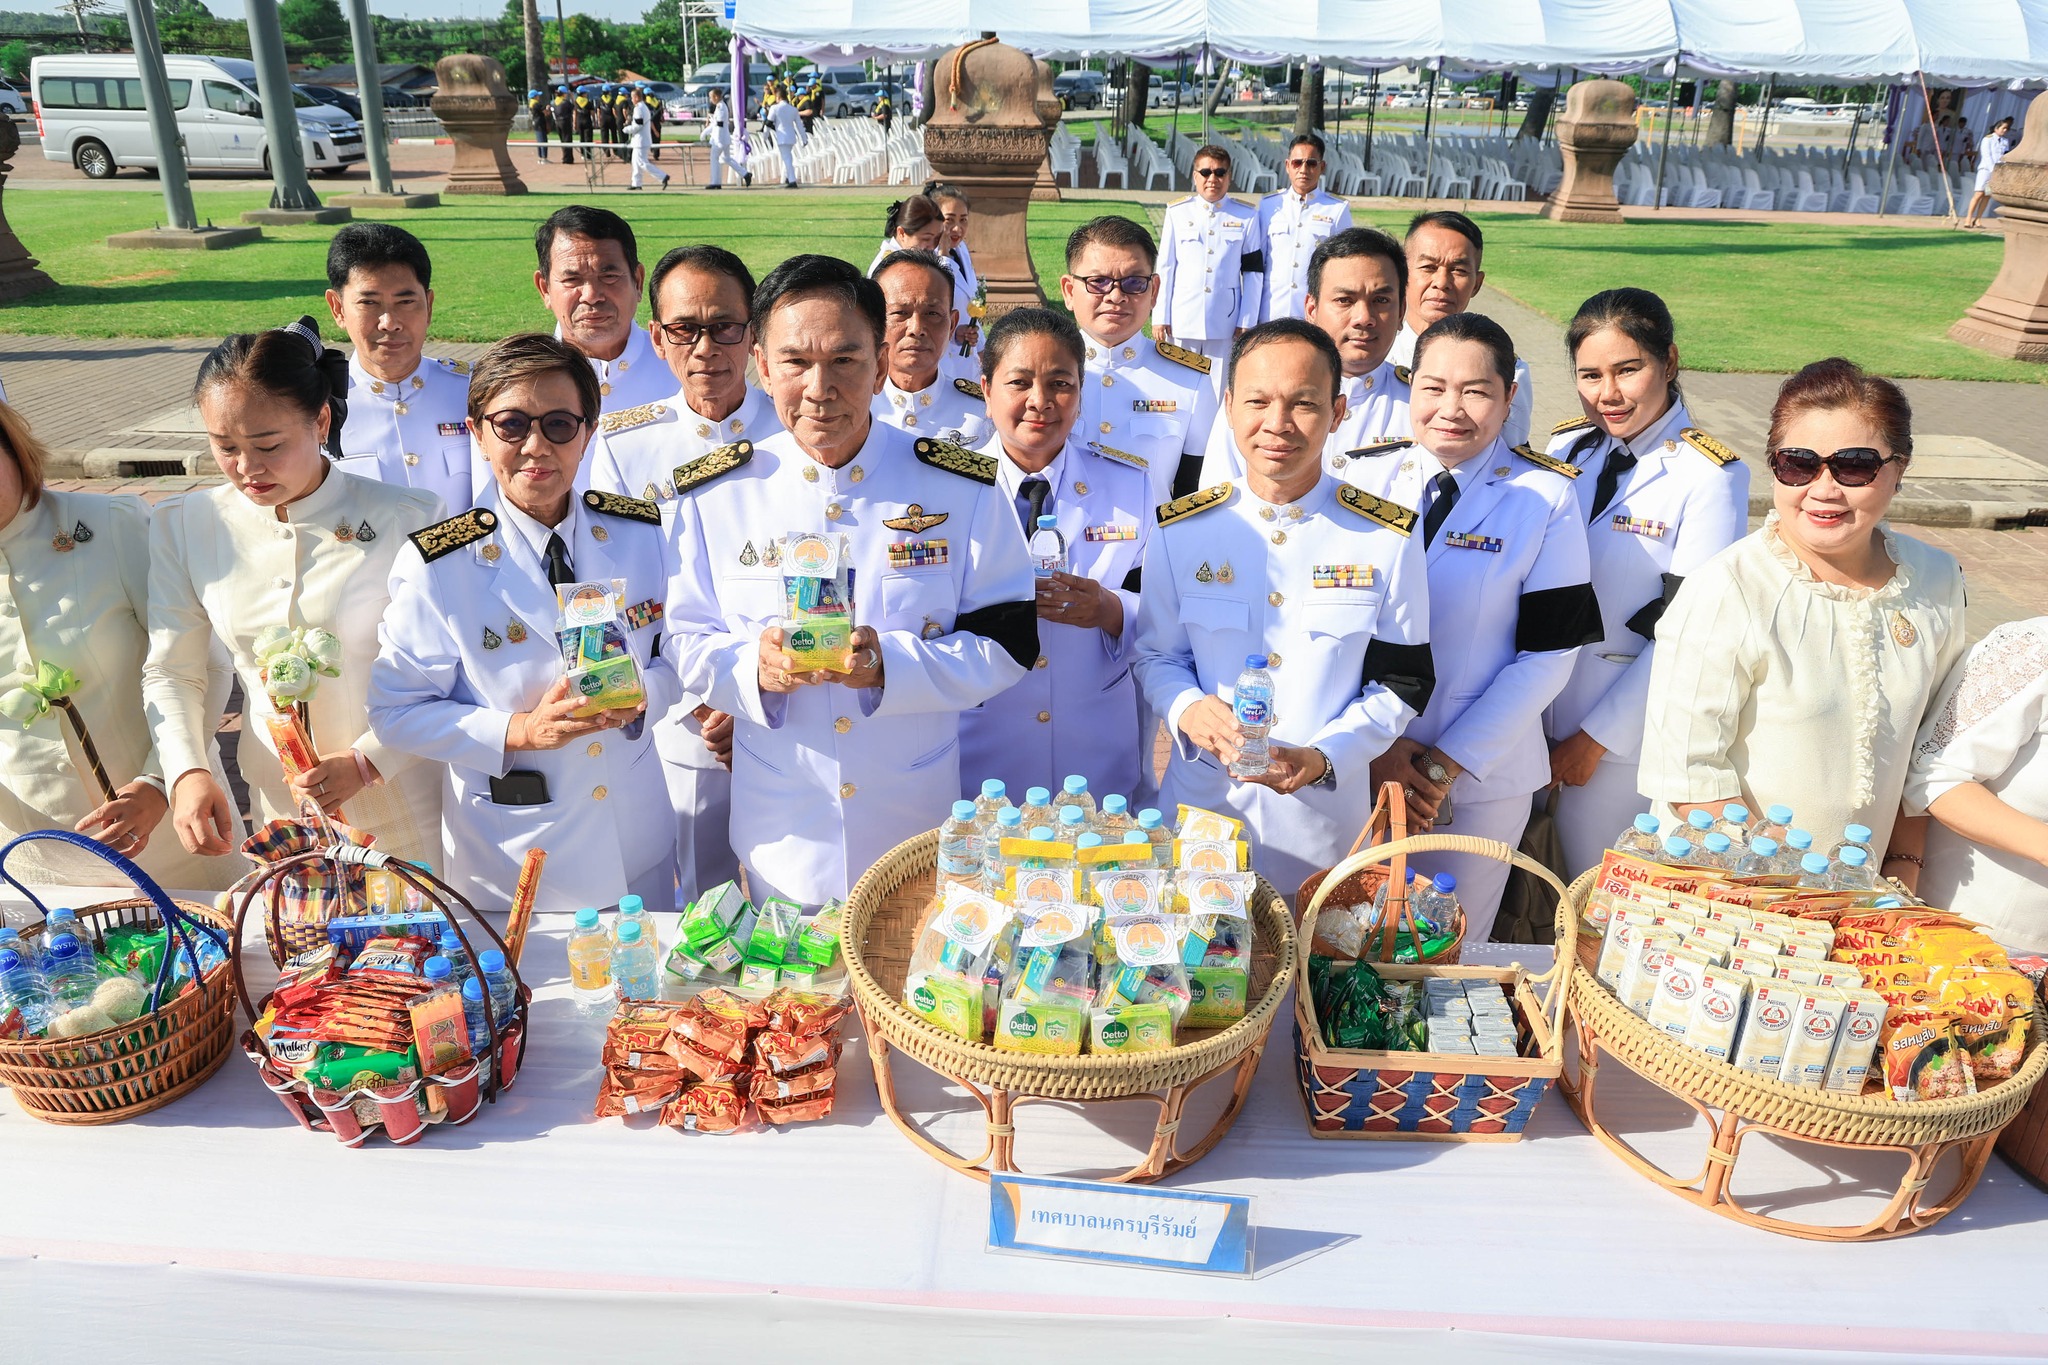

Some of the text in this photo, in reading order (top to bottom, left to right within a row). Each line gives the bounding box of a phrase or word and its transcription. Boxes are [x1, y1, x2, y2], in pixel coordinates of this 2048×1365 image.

[792, 638, 814, 646] Dettol
[580, 679, 602, 692] Dettol
[1611, 864, 1649, 883] มาม่า
[1603, 879, 1631, 897] โจ๊ก
[51, 940, 79, 952] CRYSTAL
[286, 945, 325, 968] Malkist
[363, 953, 408, 965] Malkist
[914, 993, 936, 1005] Dettol
[1010, 1021, 1037, 1032] Dettol
[1759, 1016, 1788, 1028] BEAR BRAND
[1960, 1020, 2002, 1036] สหมูสับ
[1102, 1030, 1128, 1039] Dettol
[1804, 1026, 1834, 1037] BEAR BRAND
[1847, 1028, 1875, 1039] BEAR BRAND
[1892, 1027, 1937, 1051] รสหมูสับ
[274, 1040, 313, 1060] Malkist
[1030, 1208, 1197, 1240] เทศบาลนครบุรีรัมย์
